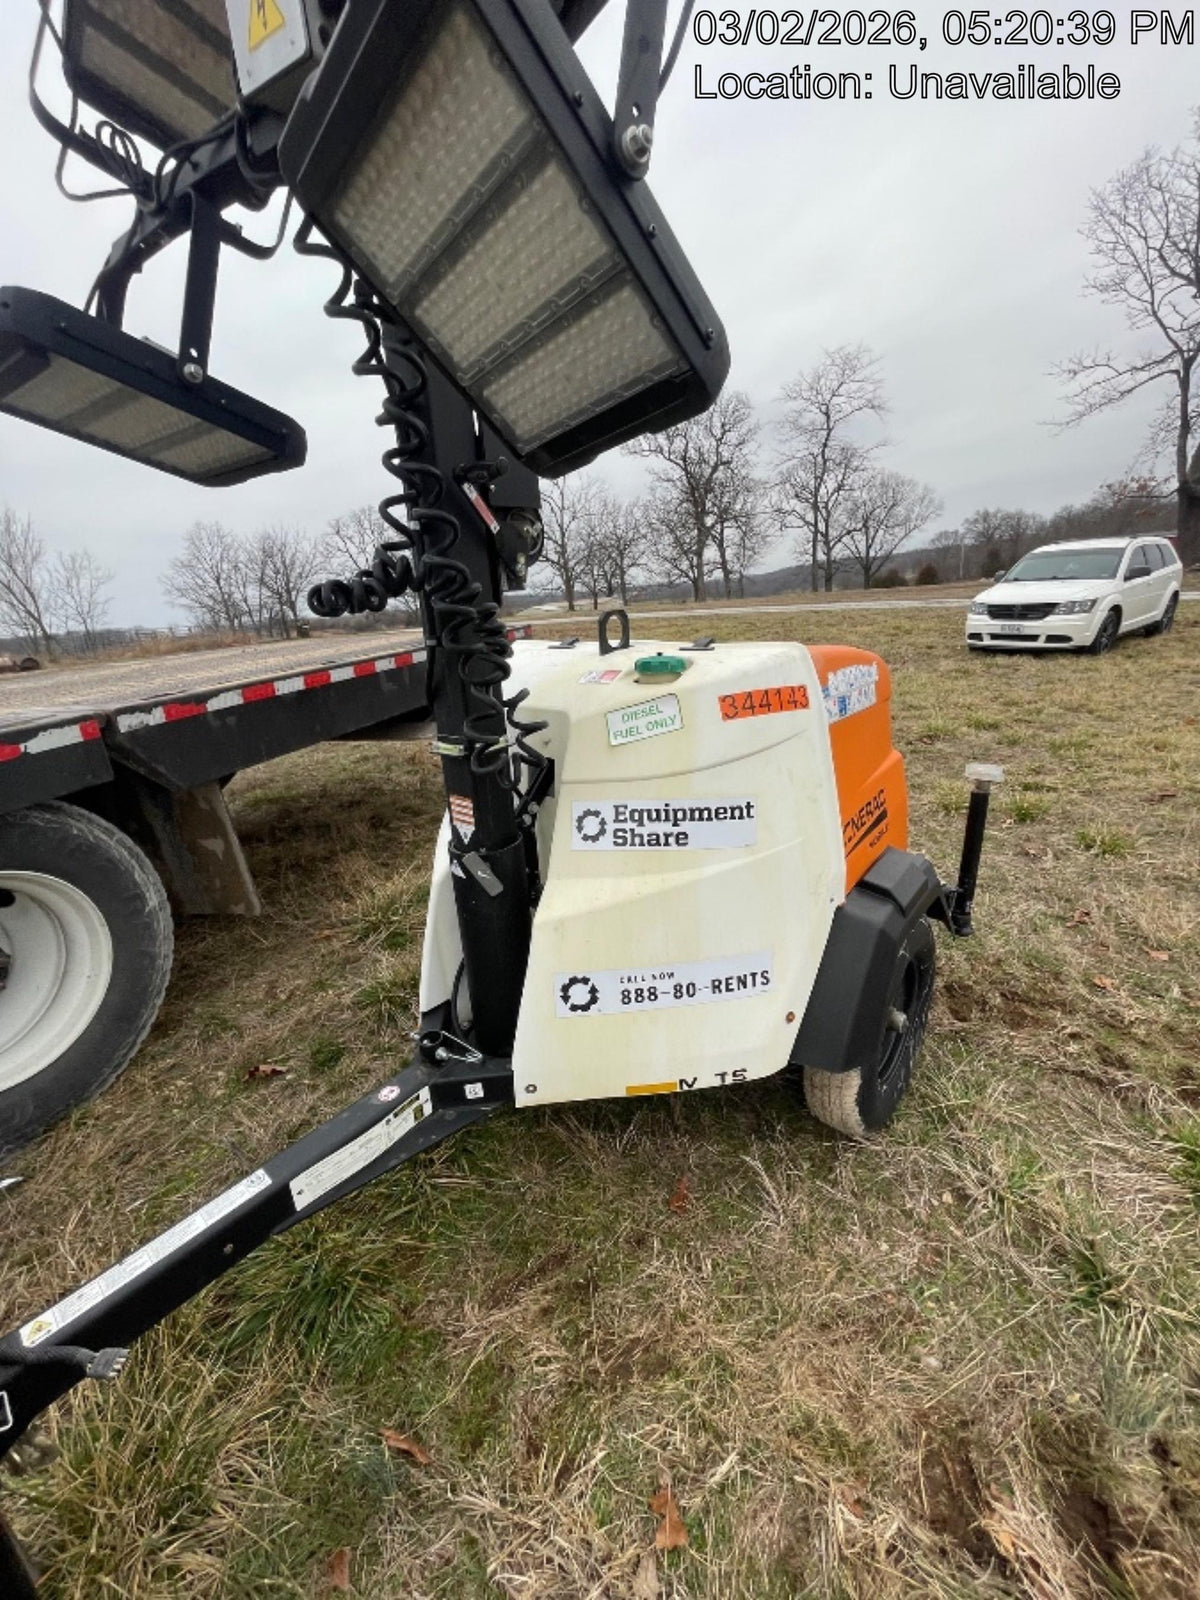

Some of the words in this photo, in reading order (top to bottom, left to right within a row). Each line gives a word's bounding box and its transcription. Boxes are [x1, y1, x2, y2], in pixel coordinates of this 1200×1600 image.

[720, 685, 810, 719] 344143
[621, 704, 664, 724] DIESEL
[612, 725, 643, 741] FUEL
[645, 714, 677, 732] ONLY
[612, 801, 755, 828] Equipment
[612, 828, 689, 847] Share
[619, 973, 647, 985] CALL
[651, 971, 676, 981] NOW
